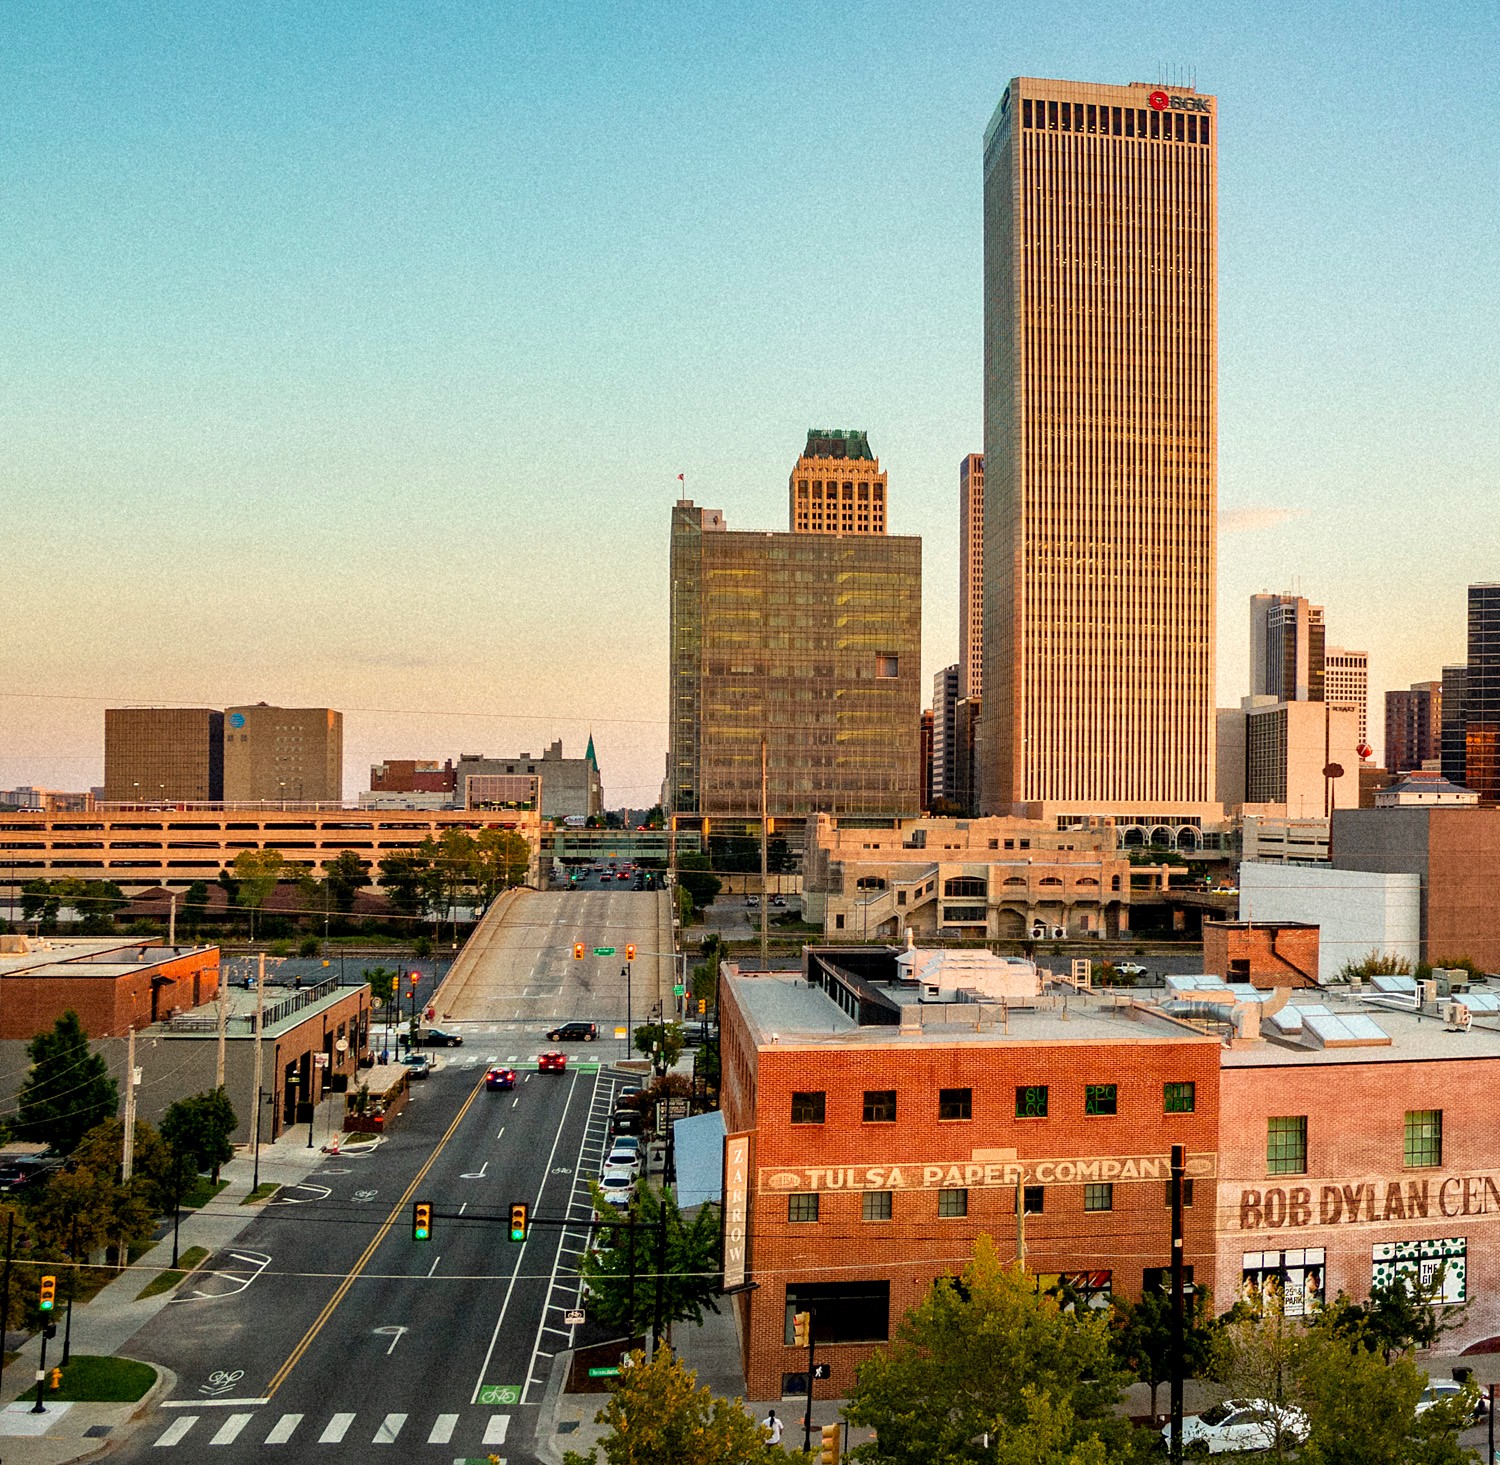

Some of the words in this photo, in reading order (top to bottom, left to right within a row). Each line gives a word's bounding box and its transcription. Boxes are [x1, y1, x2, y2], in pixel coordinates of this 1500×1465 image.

[1170, 95, 1212, 113] BOK
[805, 1168, 906, 1188] TULSA
[923, 1164, 1023, 1187] PAPER
[1035, 1158, 1172, 1182] COMPANY
[729, 1149, 743, 1262] ZARROW
[1240, 1187, 1311, 1229] BOB
[1319, 1180, 1429, 1225] DYLAN
[1422, 1264, 1437, 1274] THE
